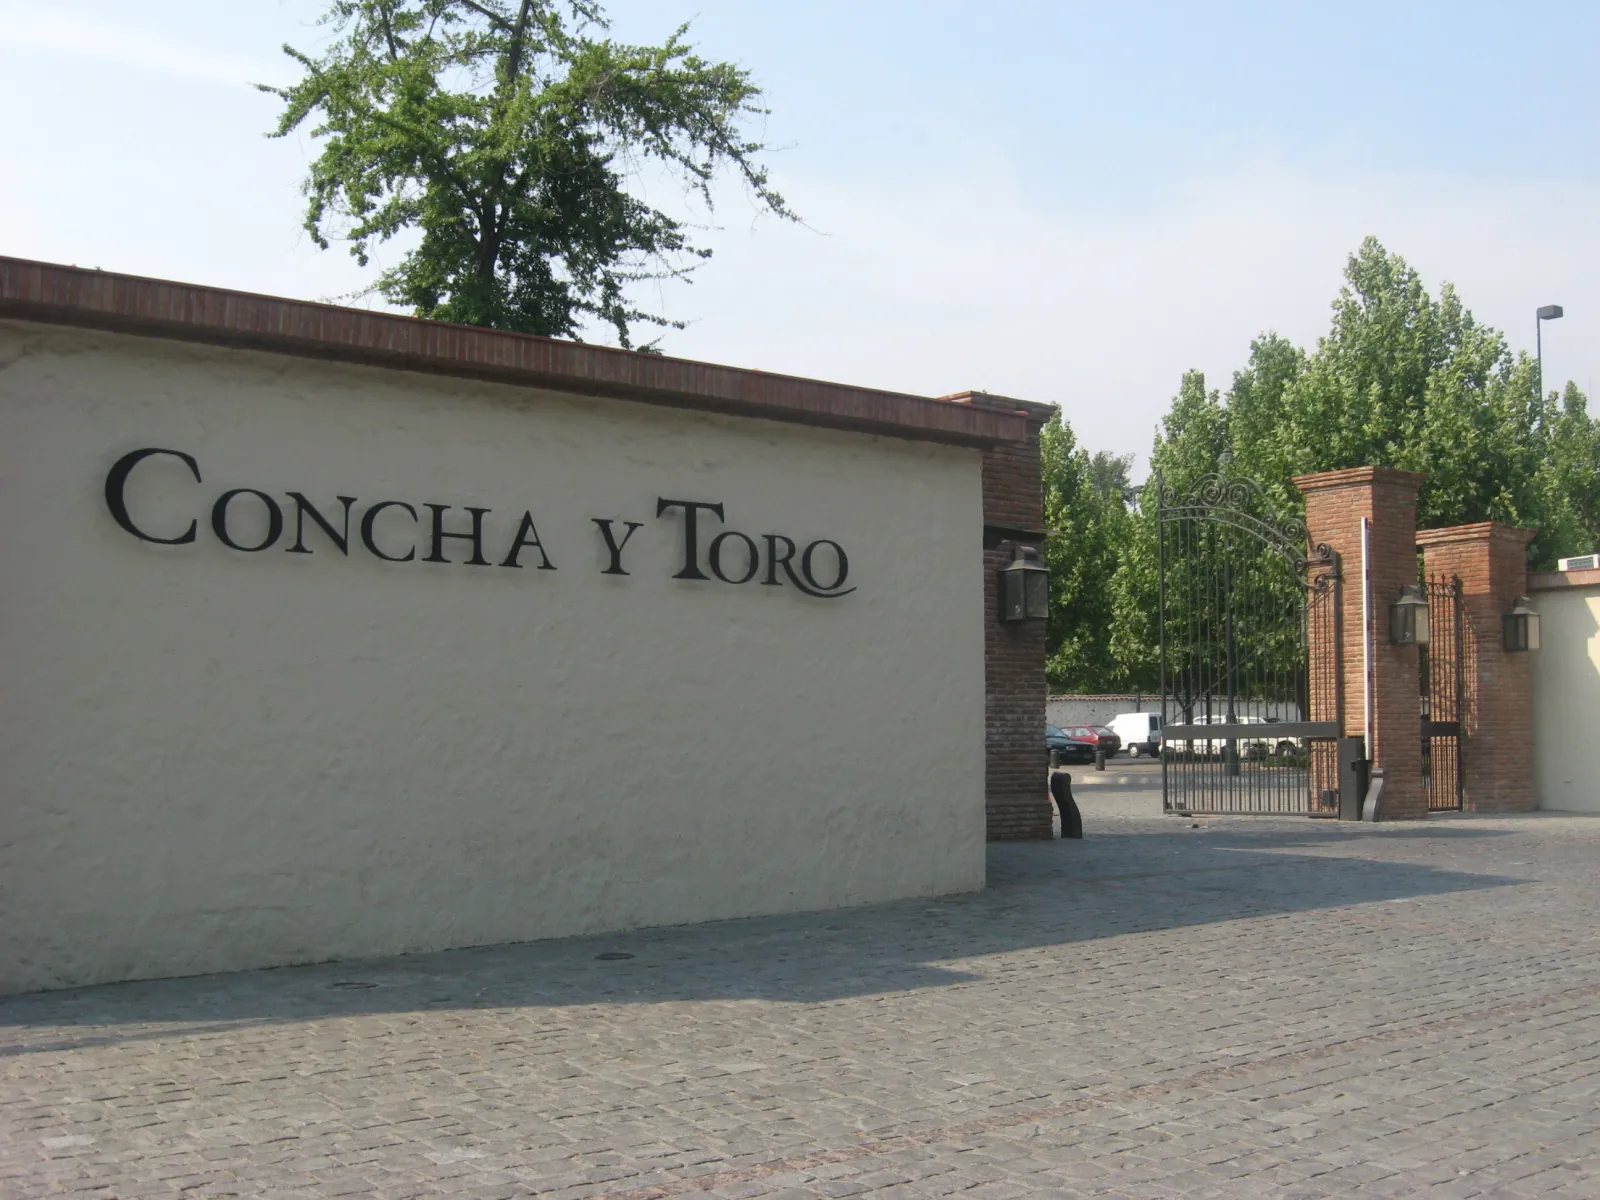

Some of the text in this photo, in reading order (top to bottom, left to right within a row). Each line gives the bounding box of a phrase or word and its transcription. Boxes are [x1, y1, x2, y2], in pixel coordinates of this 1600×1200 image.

[104, 447, 858, 599] CONCHA Y TORO
